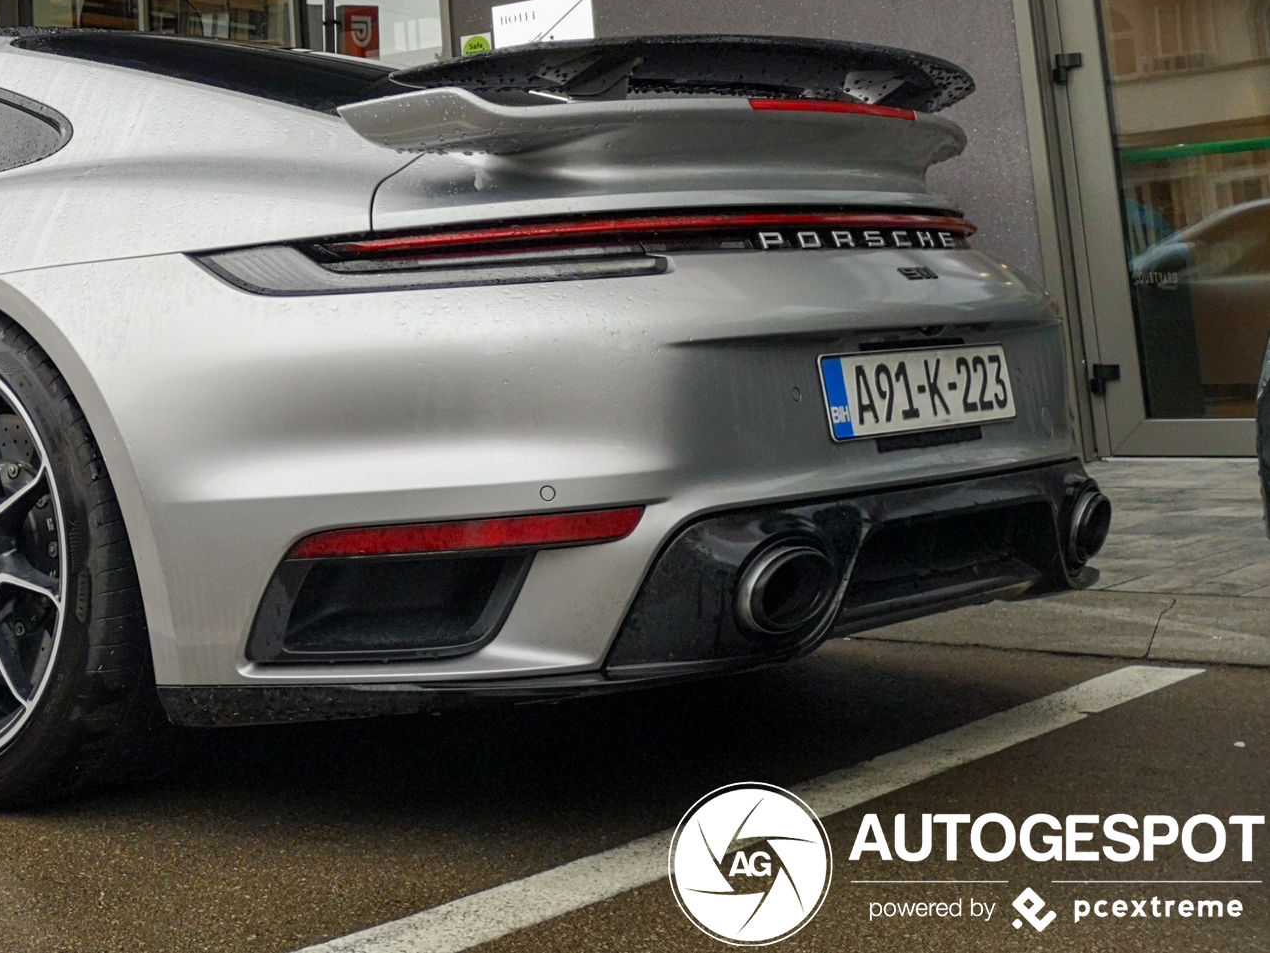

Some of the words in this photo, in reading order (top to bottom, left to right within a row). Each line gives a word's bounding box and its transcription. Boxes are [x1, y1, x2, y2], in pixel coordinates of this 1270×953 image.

[758, 230, 956, 249] PORSCHE
[854, 353, 1009, 426] A91-K-223
[830, 405, 851, 424] BIH
